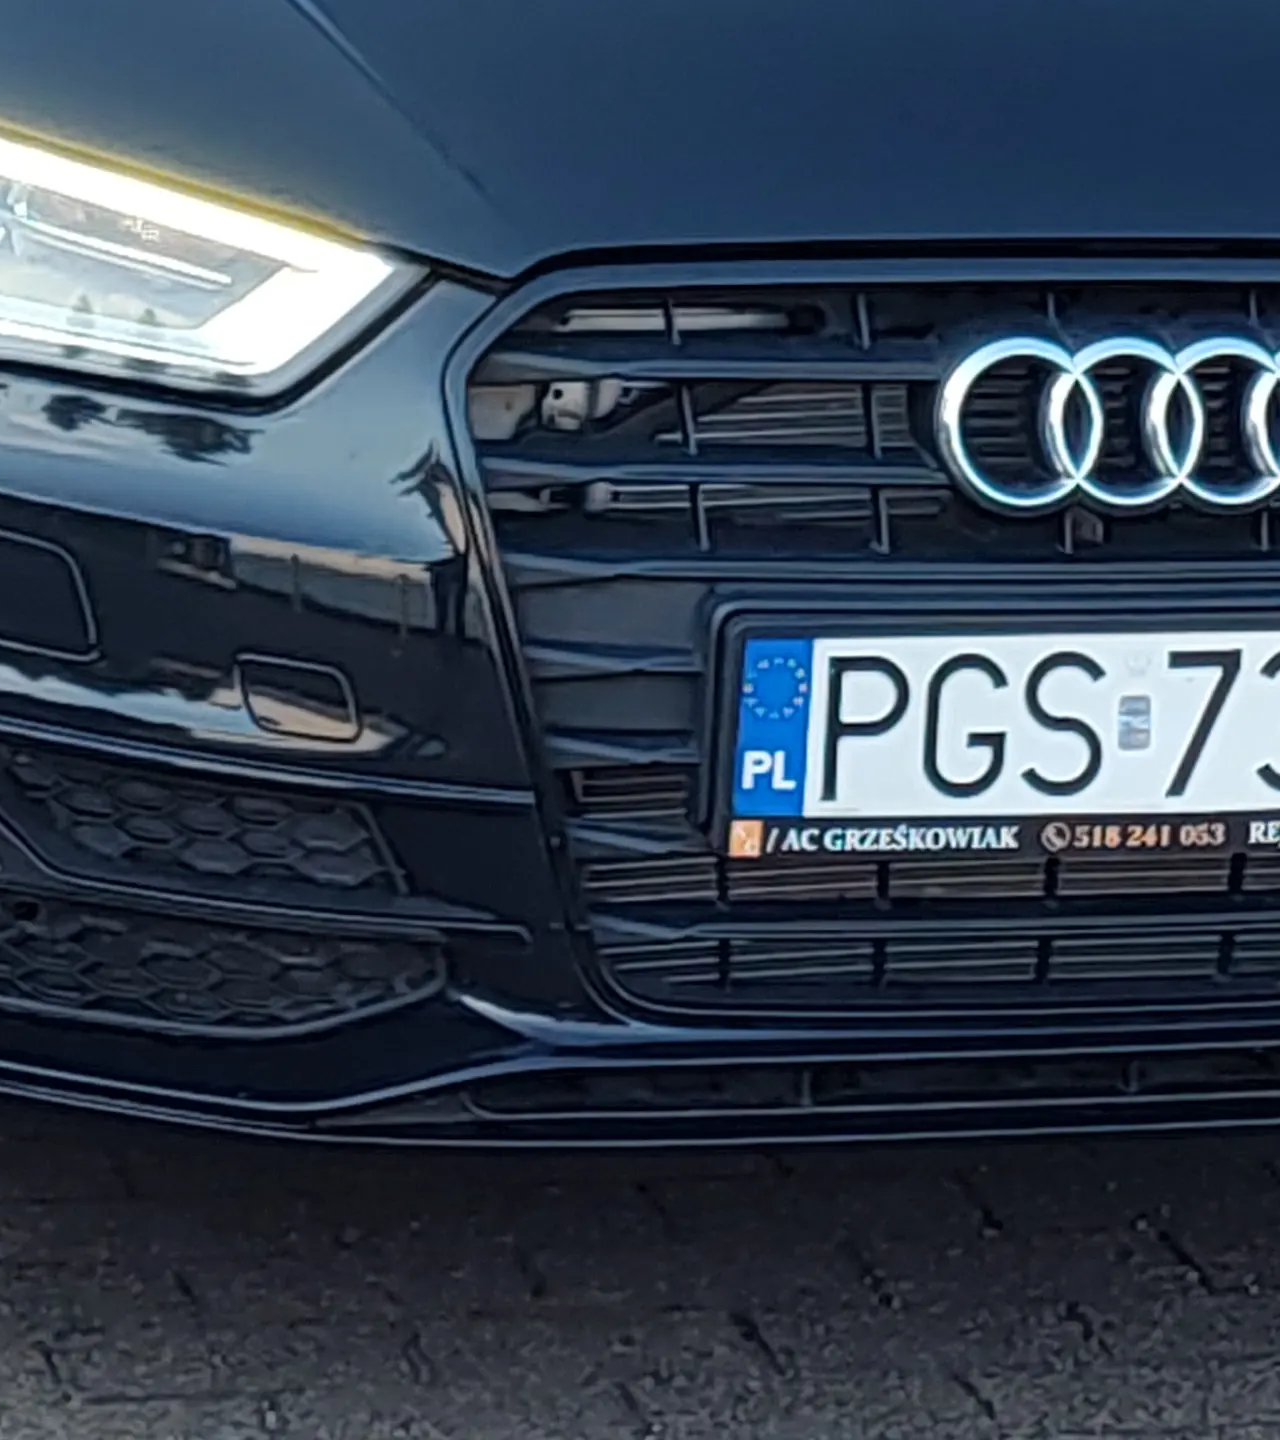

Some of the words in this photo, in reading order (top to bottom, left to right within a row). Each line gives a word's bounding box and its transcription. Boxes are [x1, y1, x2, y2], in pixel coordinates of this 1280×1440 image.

[820, 651, 1106, 802] PGS
[741, 750, 797, 790] PL
[781, 828, 819, 851] AC
[823, 824, 1019, 851] GRZEŚKOWIAK
[1125, 825, 1170, 847] 241
